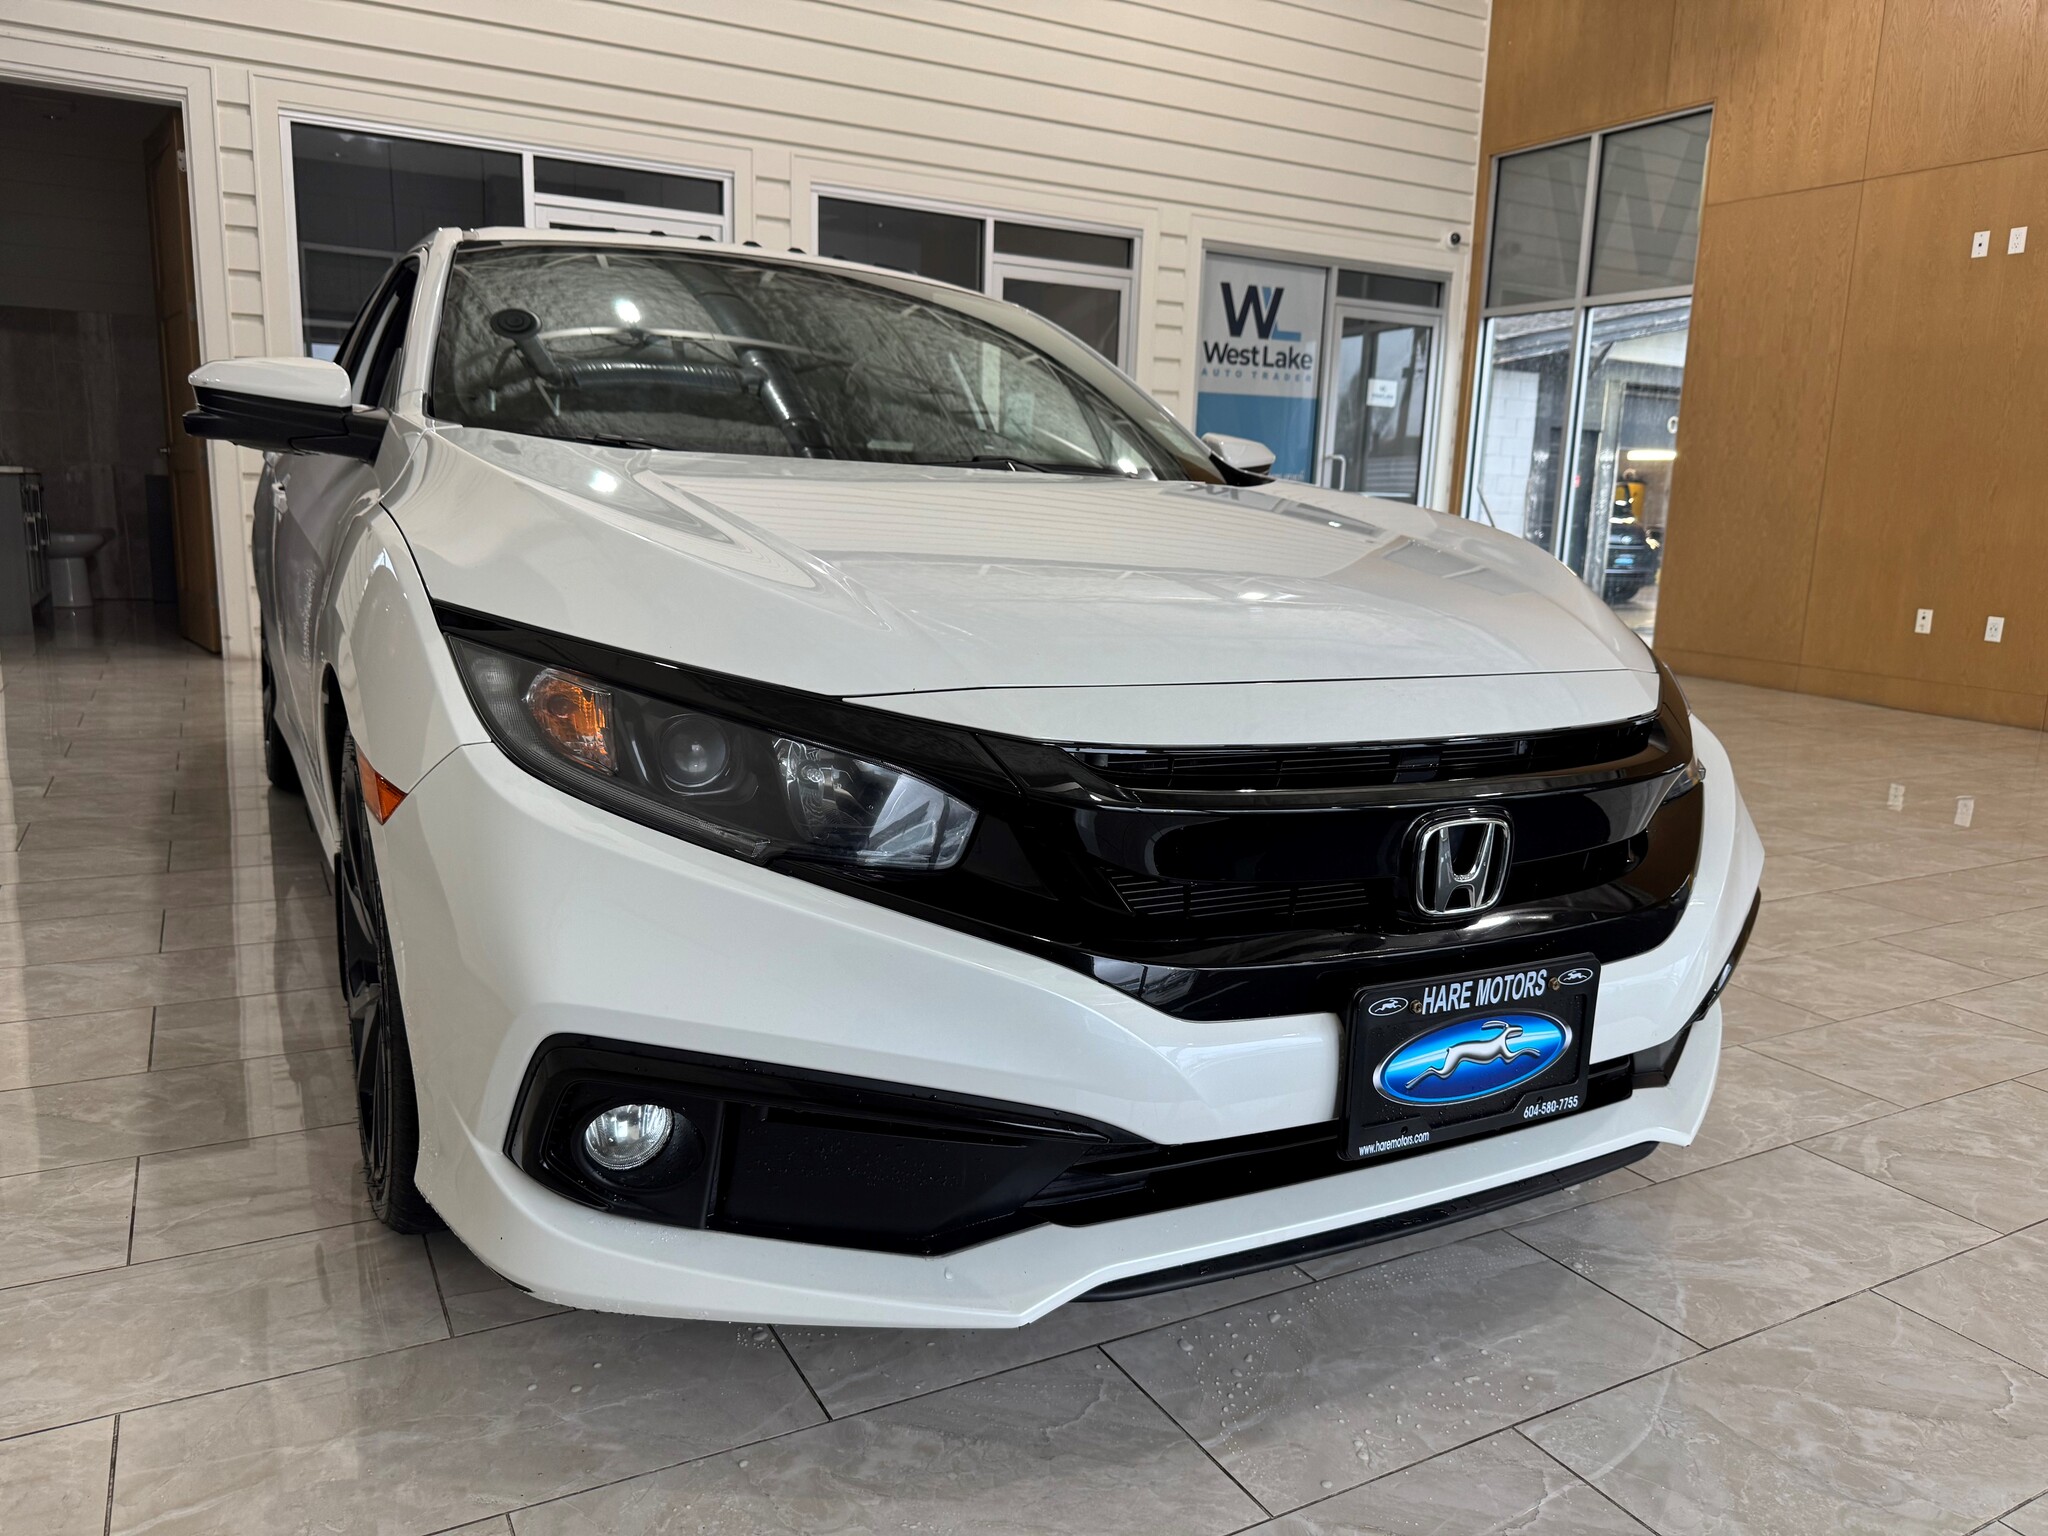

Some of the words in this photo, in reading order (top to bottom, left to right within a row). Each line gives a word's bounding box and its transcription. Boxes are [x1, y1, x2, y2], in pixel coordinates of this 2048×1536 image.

[1201, 367, 1243, 379] AUTO
[1421, 982, 1472, 1015] HARE
[1475, 969, 1547, 1006] MOTORS
[1523, 1095, 1579, 1119] 604-580-7755
[1358, 1131, 1430, 1156] www.haremotors.com
